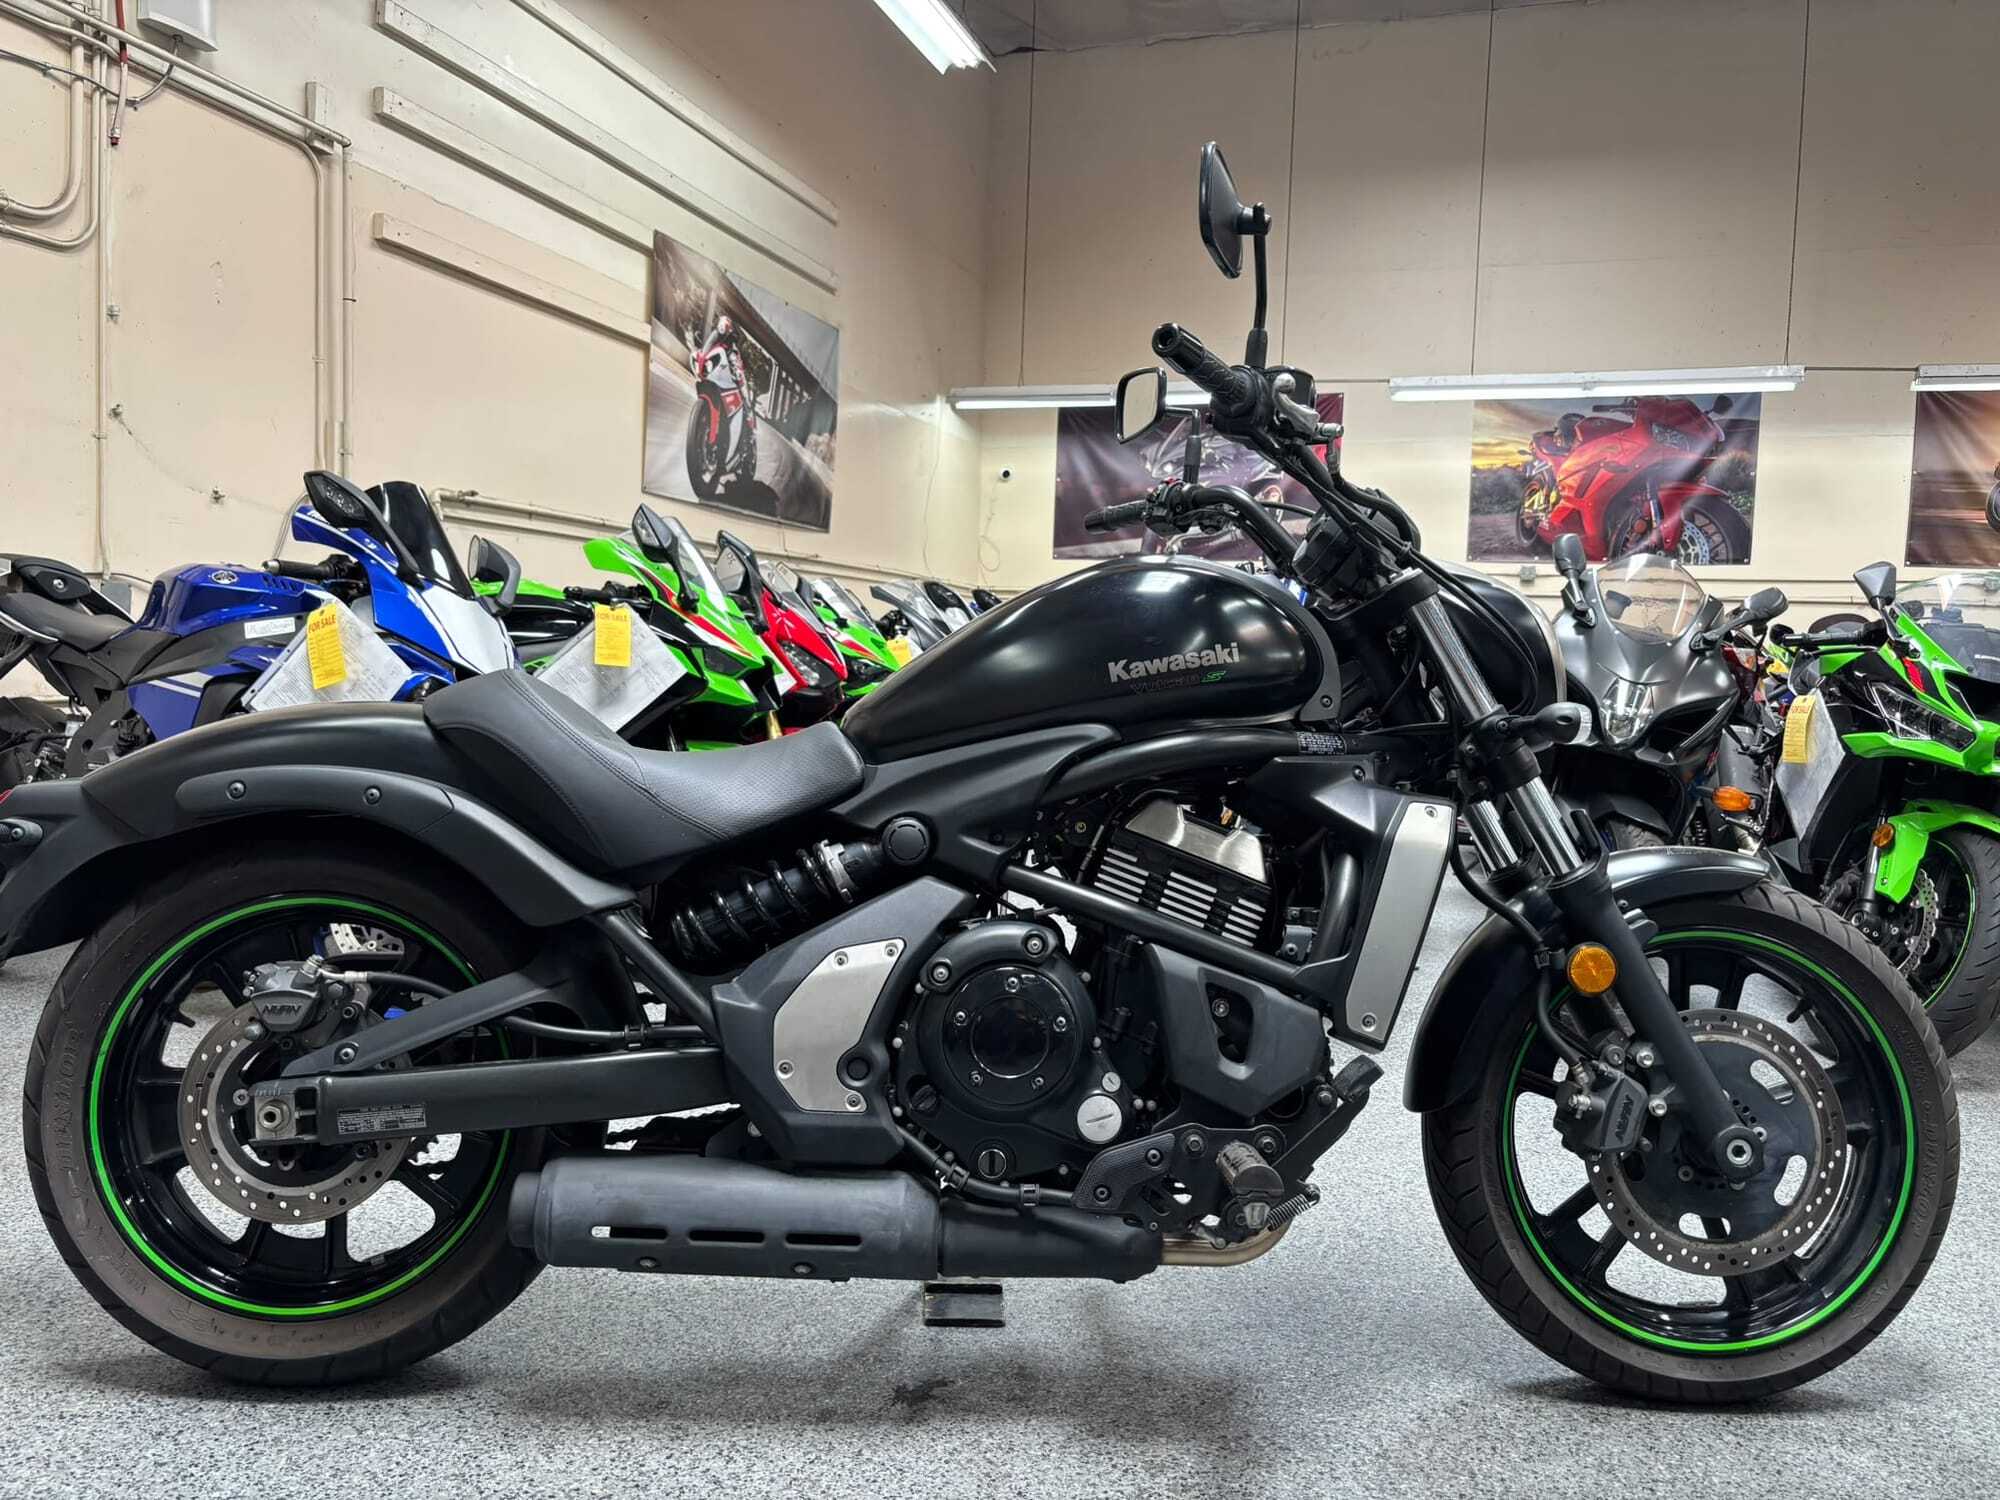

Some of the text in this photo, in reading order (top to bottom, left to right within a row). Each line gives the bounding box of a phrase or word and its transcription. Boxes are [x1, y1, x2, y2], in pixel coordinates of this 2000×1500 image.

[308, 621, 321, 633] FOR
[321, 614, 336, 629] SALE
[1107, 642, 1240, 683] Kawasaki
